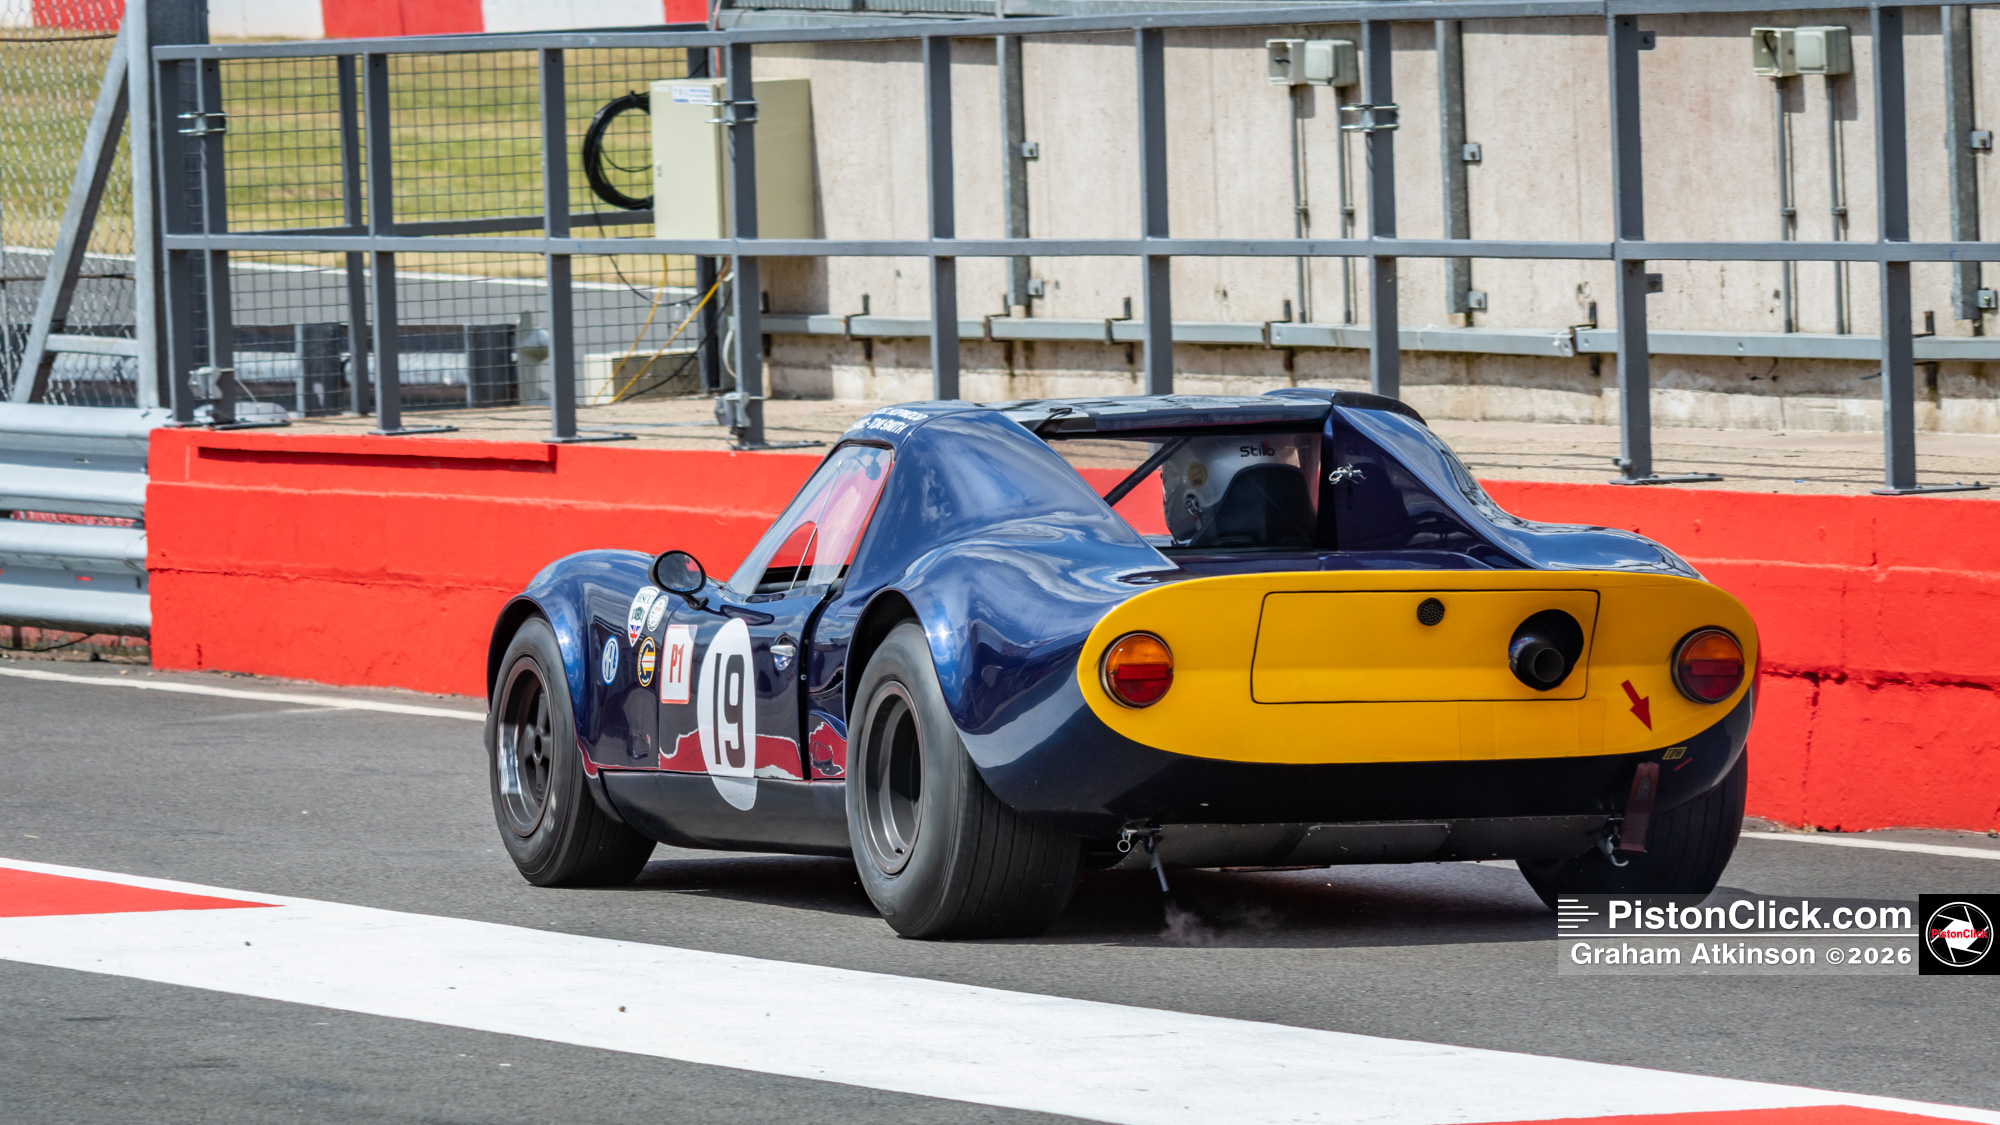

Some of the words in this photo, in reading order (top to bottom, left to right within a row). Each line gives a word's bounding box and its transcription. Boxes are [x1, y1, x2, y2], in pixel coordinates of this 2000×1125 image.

[1239, 439, 1275, 457] Stilo
[669, 644, 685, 683] P1
[713, 653, 745, 768] 19
